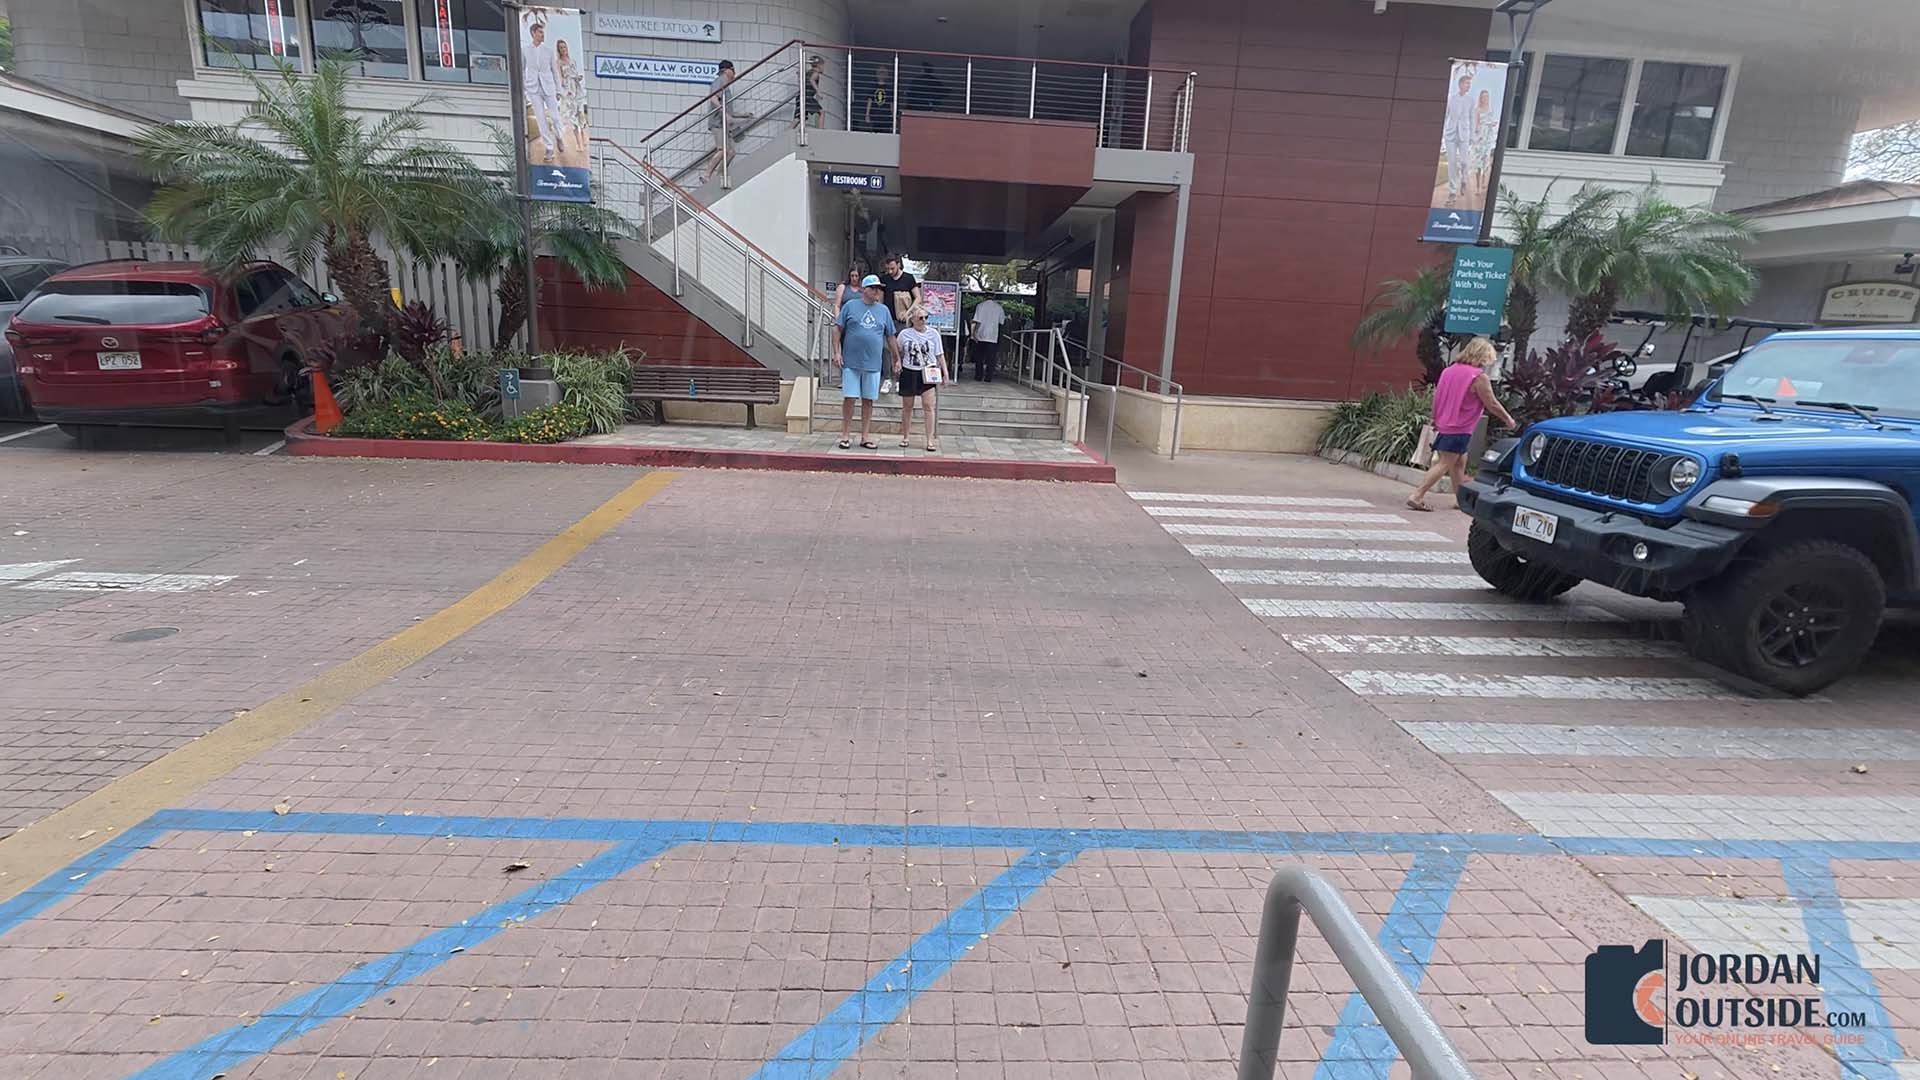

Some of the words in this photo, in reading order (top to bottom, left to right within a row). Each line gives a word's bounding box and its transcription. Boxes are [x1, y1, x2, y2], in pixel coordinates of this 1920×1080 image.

[599, 18, 634, 30] BANYAN
[635, 20, 657, 32] TREE
[663, 22, 698, 34] TATTOO
[600, 60, 628, 74] AVA
[628, 62, 650, 72] AVA
[653, 64, 677, 73] LAW
[680, 65, 717, 75] GROUP
[832, 175, 868, 186] RESTROOMS
[1459, 259, 1476, 268] Take
[1477, 260, 1495, 269] Your
[1456, 270, 1484, 280] Parking
[1485, 271, 1507, 280] Ticket
[1455, 280, 1472, 289] With
[1473, 281, 1488, 289] You
[1831, 287, 1914, 300] CRUISE
[1478, 300, 1489, 308] Pay
[1469, 307, 1497, 316] Returning
[1449, 313, 1457, 321] To
[1536, 519, 1554, 537] 210
